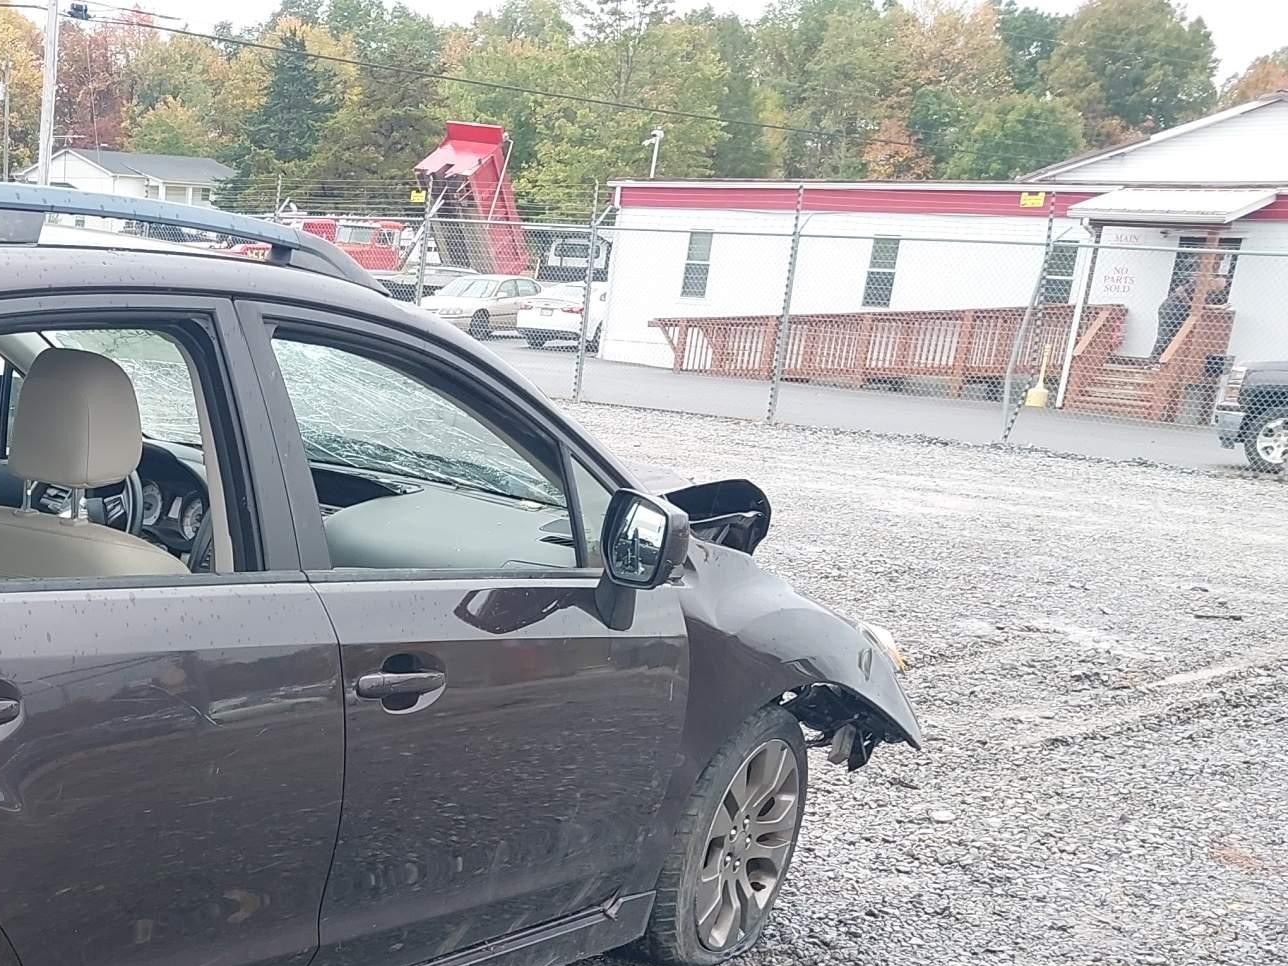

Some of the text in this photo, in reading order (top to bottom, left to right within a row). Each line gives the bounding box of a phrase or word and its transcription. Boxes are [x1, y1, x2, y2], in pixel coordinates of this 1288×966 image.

[1113, 233, 1140, 242] MAIN
[1114, 266, 1128, 275] NO
[1103, 276, 1136, 284] PARTS
[1104, 285, 1130, 293] SOLD
